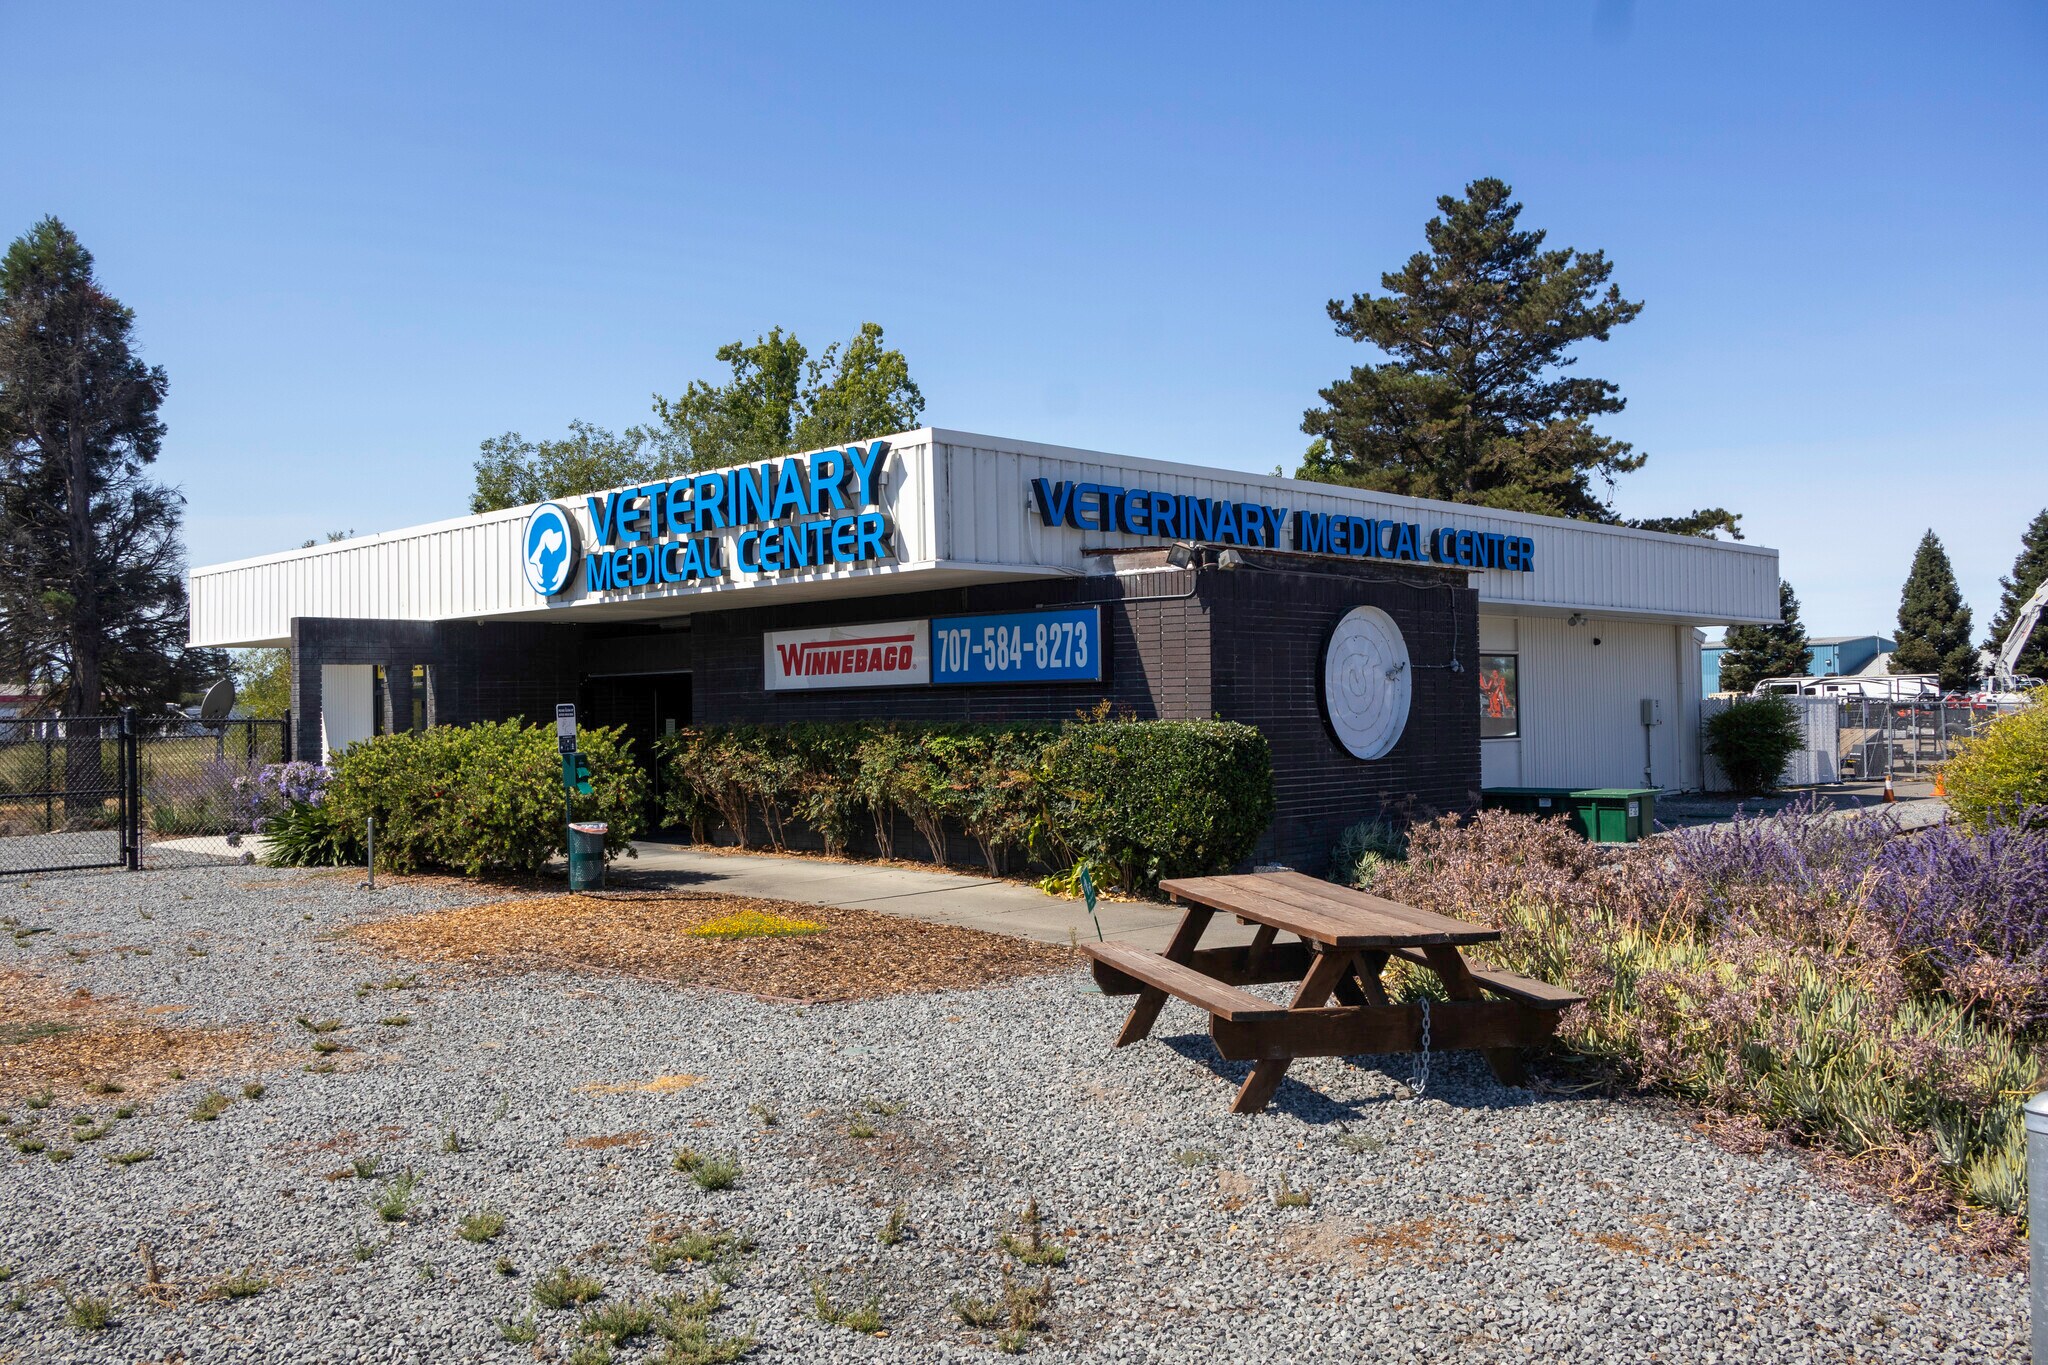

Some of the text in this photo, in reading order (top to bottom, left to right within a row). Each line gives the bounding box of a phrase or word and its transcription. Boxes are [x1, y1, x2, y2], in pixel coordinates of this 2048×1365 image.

[587, 441, 890, 546] VETERINARY
[1033, 478, 1535, 572] VETERINARY MEDICAL CENTER
[586, 513, 887, 592] MEDICAL CENTER
[777, 637, 914, 677] WINNEBAGO
[938, 621, 1088, 673] 707-584-8273
